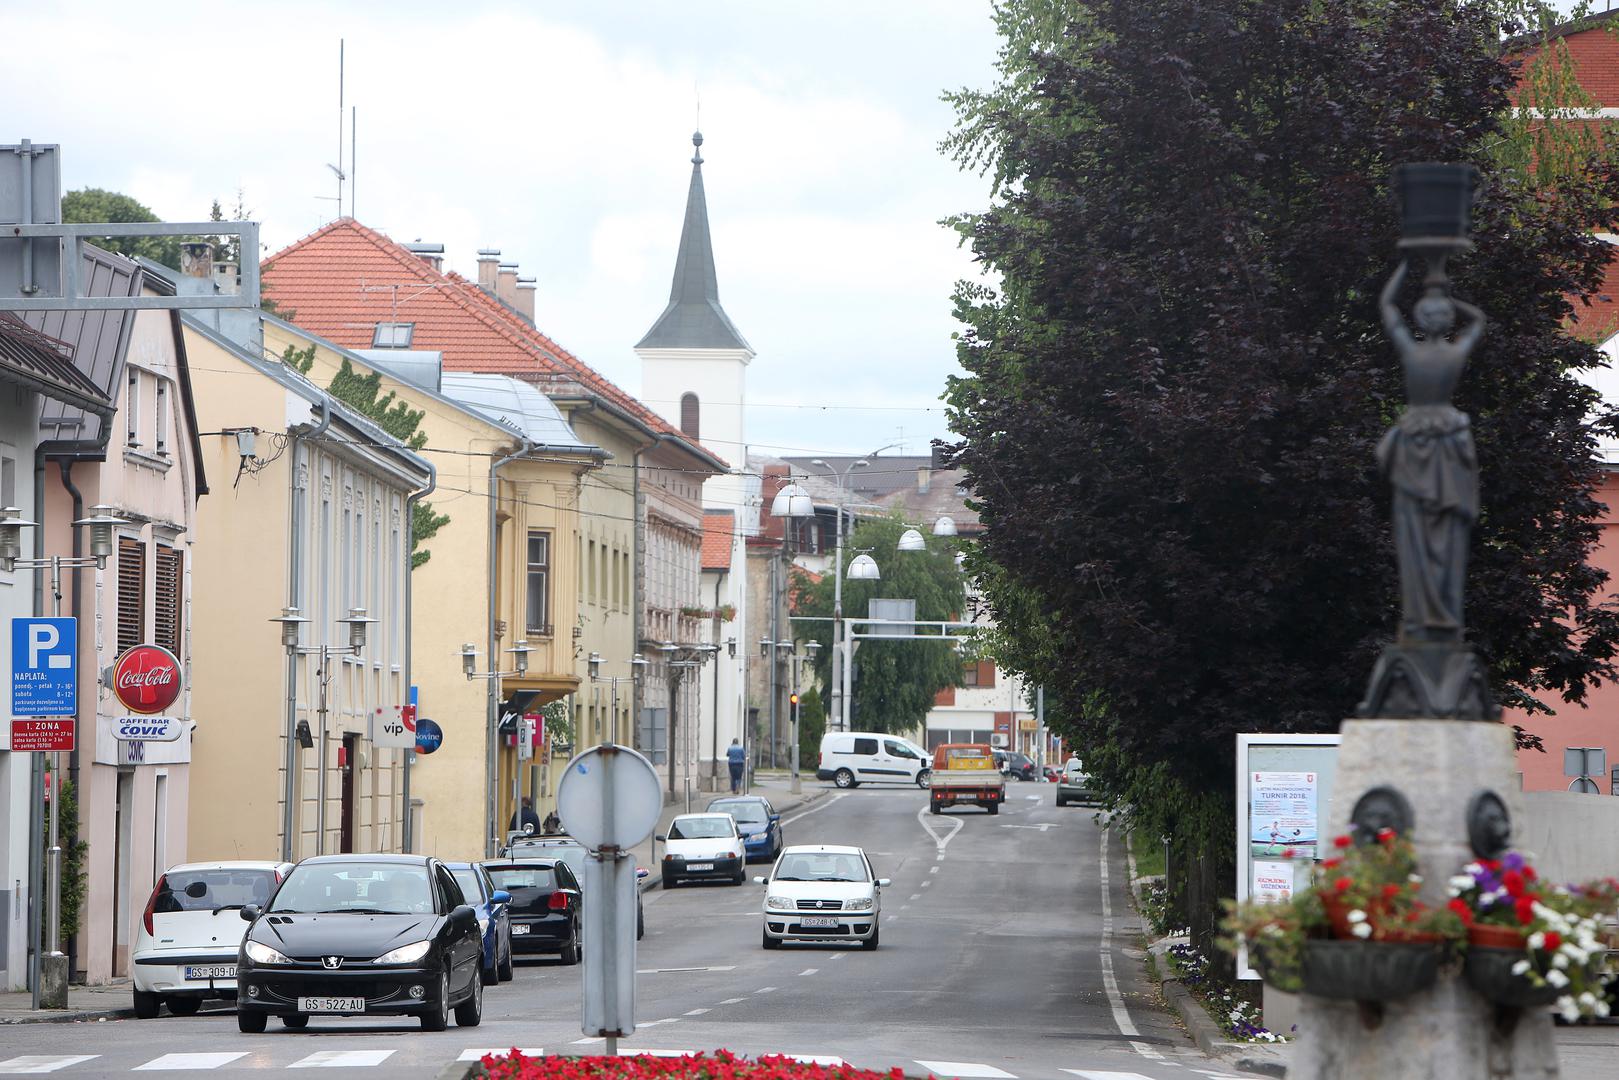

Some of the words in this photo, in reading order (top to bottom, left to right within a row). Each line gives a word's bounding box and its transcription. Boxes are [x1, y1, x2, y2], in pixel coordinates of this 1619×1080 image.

[29, 624, 59, 668] P
[14, 672, 47, 681] NAPLATA:
[119, 666, 175, 688] Coca-Cola
[26, 722, 32, 730] 1.
[35, 722, 59, 730] ZONA
[120, 724, 167, 735] ČOVIĆ
[384, 721, 404, 736] vip
[192, 967, 202, 977] GS
[305, 999, 318, 1010] GS
[326, 999, 363, 1010] 522-AU
